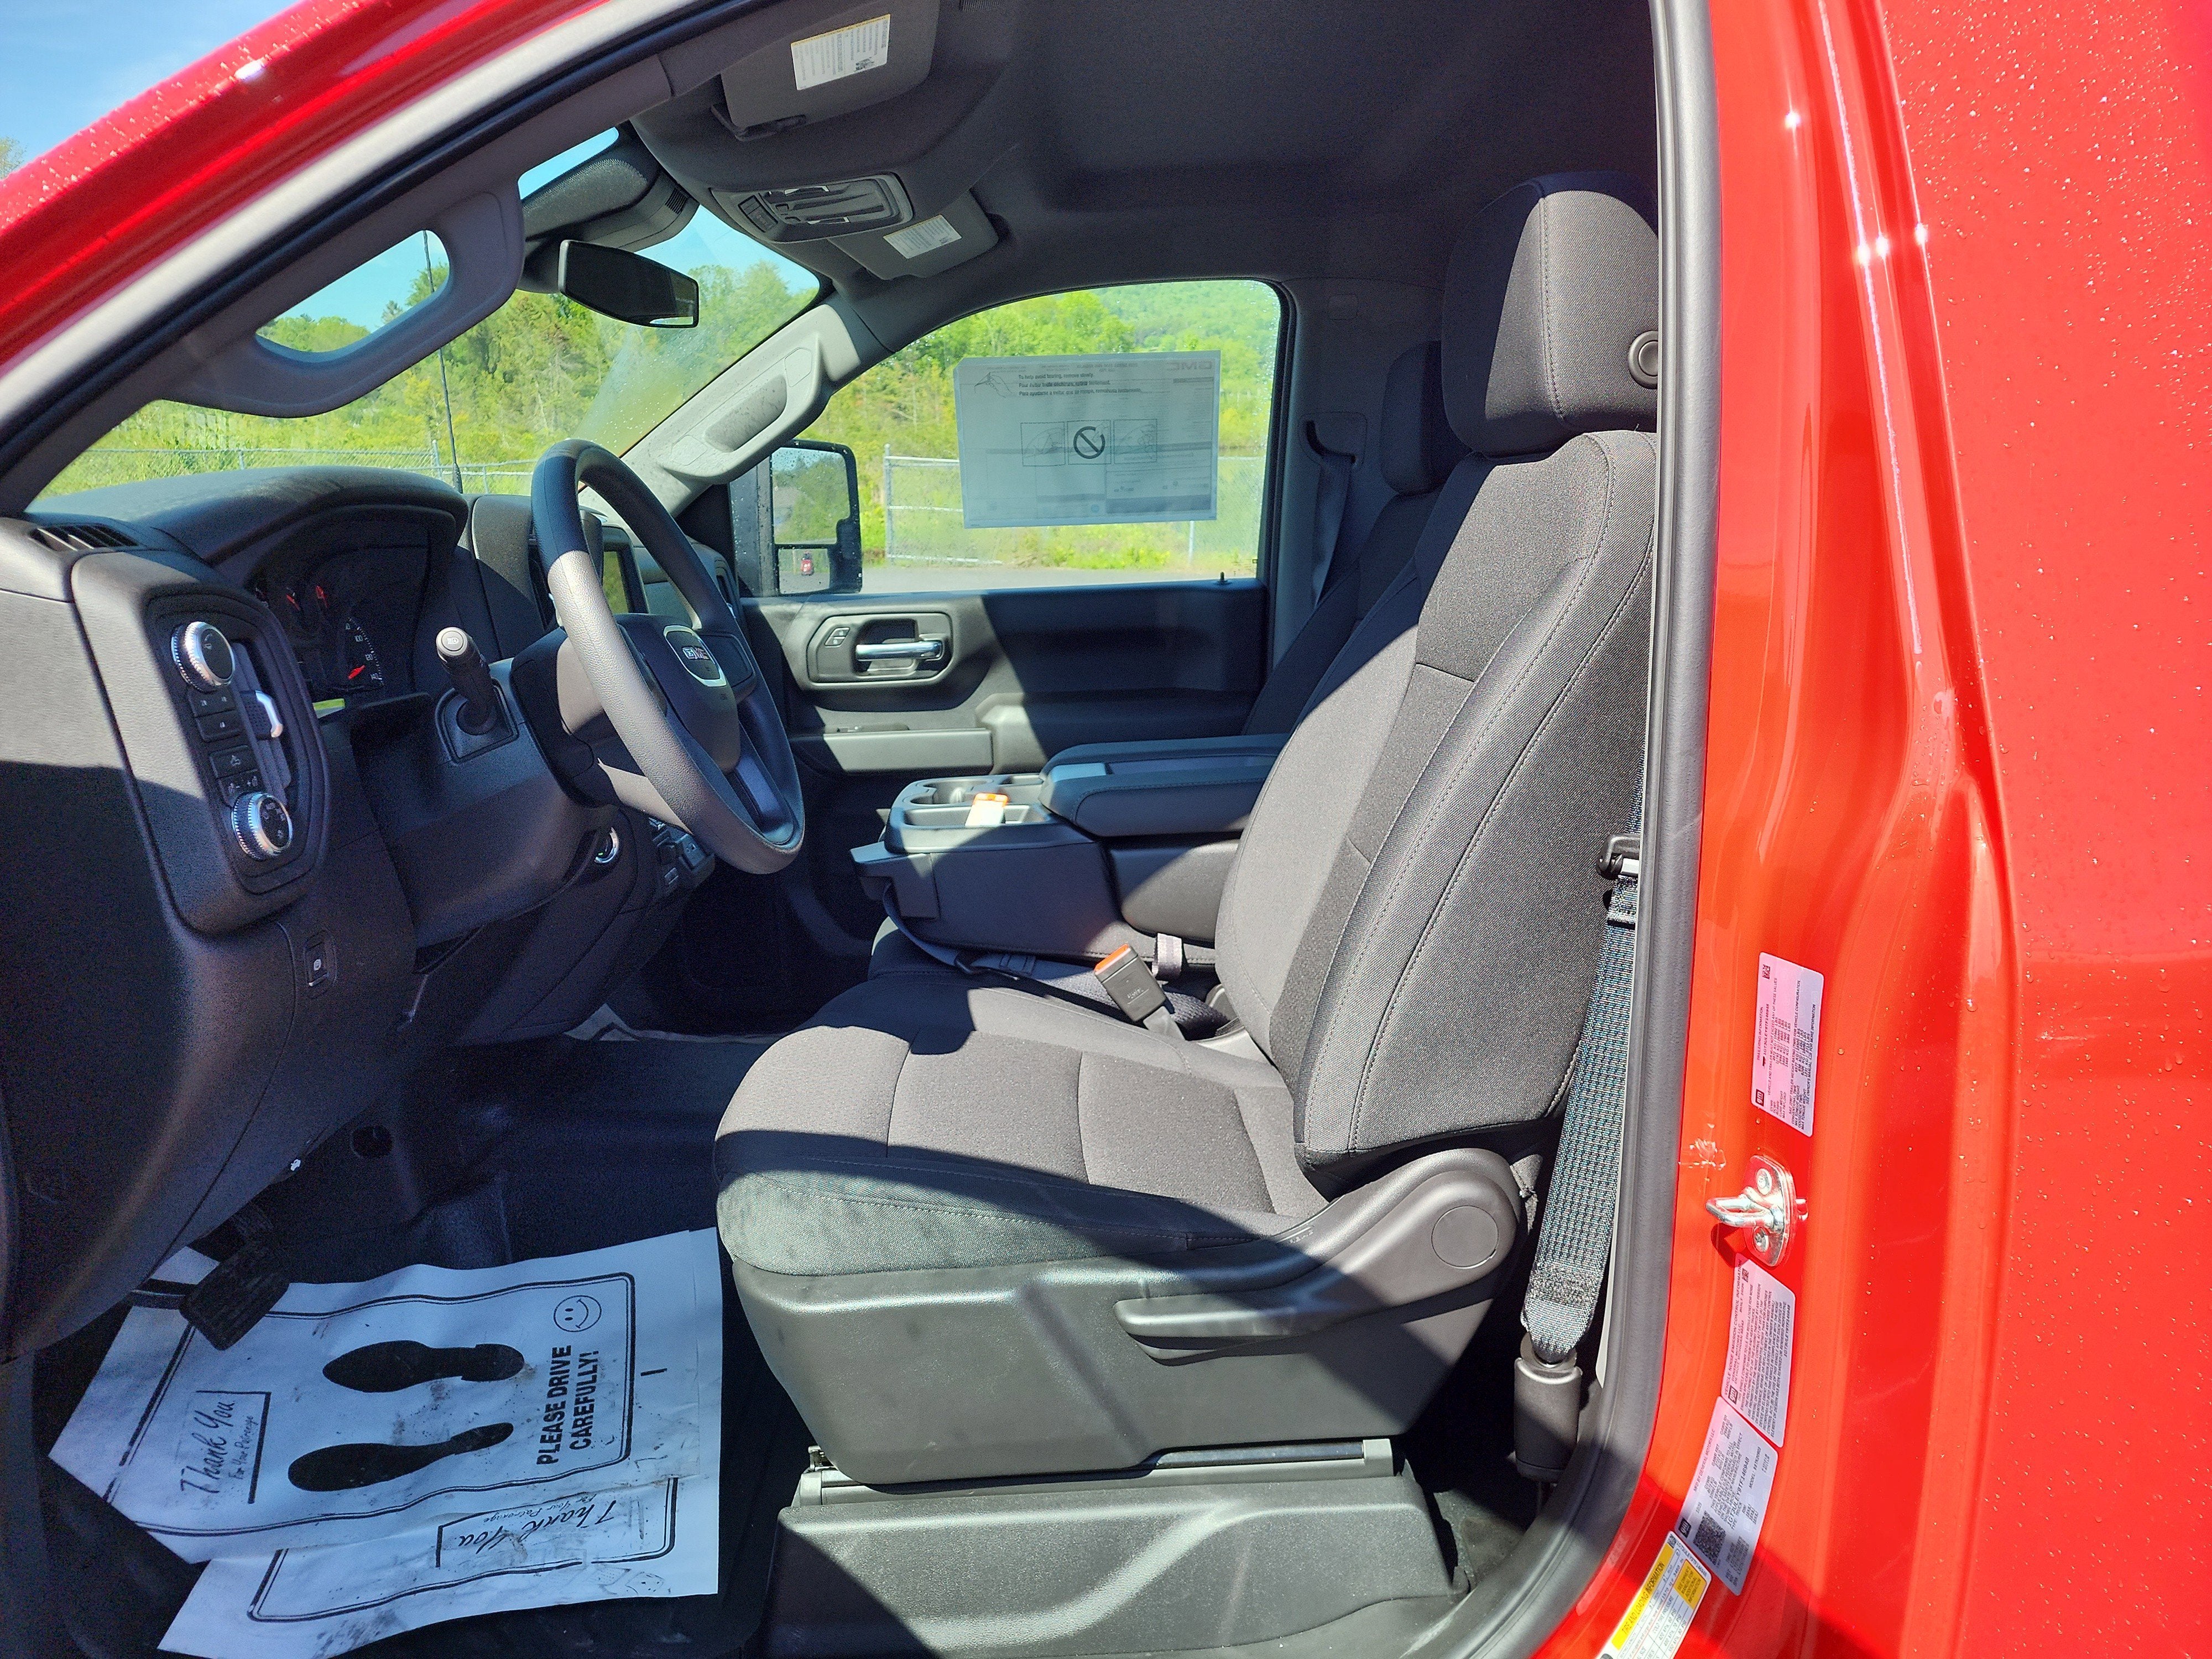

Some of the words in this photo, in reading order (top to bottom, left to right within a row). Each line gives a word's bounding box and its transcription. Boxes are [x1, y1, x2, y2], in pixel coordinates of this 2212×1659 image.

[682, 646, 709, 660] GMC
[547, 1345, 572, 1399] DRIVE
[194, 1400, 236, 1428] You
[569, 1350, 599, 1450] CAREFULLY!
[536, 1401, 566, 1465] PLEASE
[180, 1432, 228, 1493] Thank
[483, 1507, 543, 1523] Patronage
[519, 1500, 617, 1543] Thank
[546, 1500, 572, 1512] Your
[457, 1525, 507, 1554] You
[1645, 1561, 1665, 1593] INFORMATION
